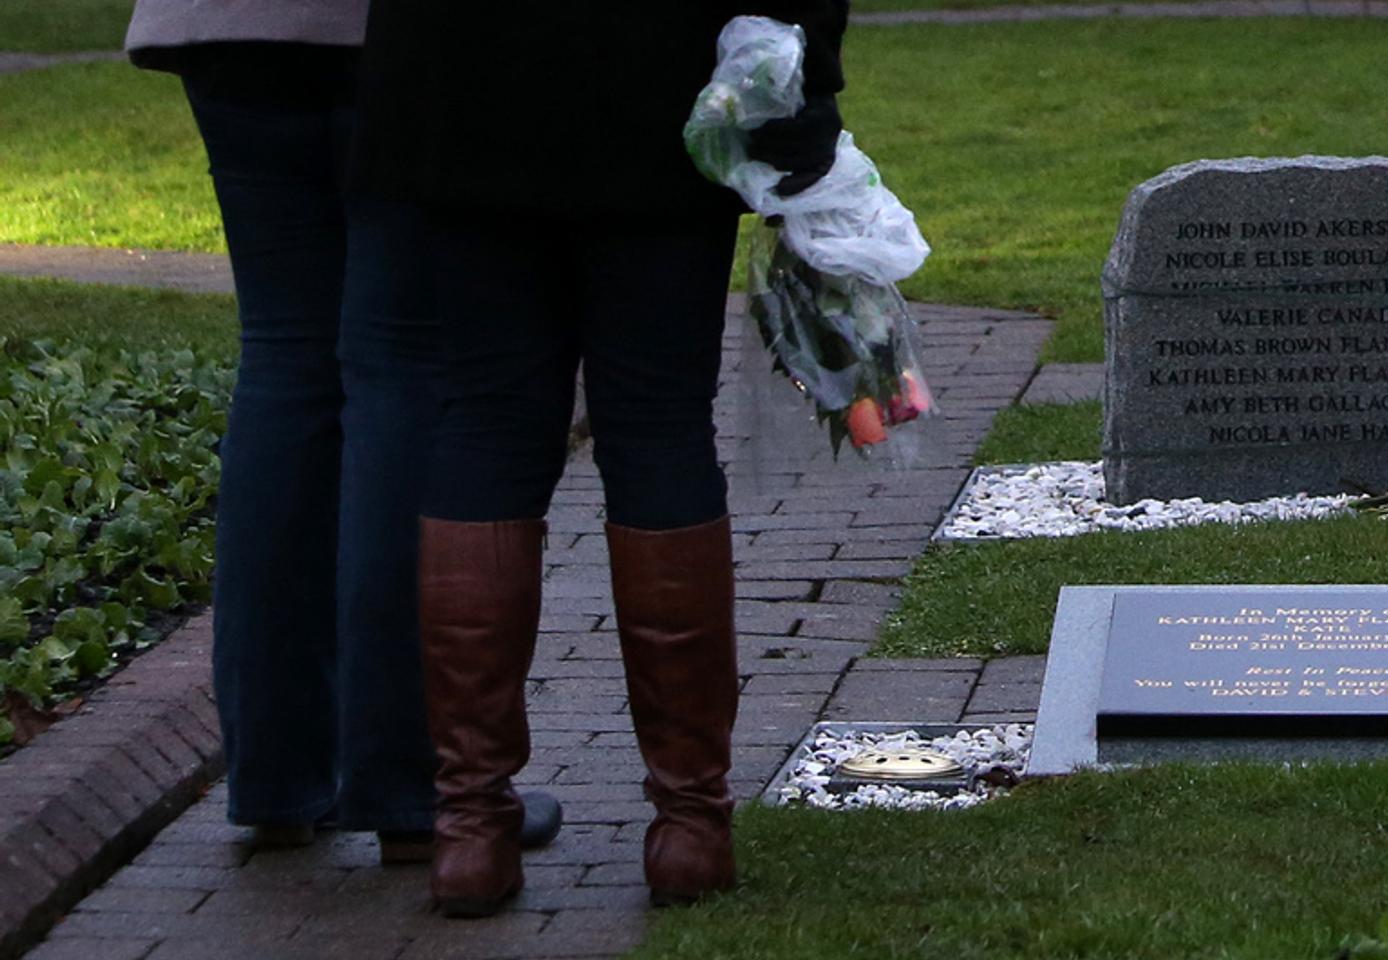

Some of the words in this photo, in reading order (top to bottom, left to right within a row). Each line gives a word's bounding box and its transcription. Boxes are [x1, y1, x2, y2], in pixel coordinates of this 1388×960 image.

[1175, 221, 1231, 240] JOHN
[1240, 220, 1308, 239] DAVID
[1165, 249, 1247, 269] NICOLE
[1256, 249, 1313, 268] ELISE
[1217, 309, 1309, 327] VALERIE
[1155, 338, 1245, 358] THOMAS
[1255, 336, 1331, 355] BROWN
[1148, 368, 1268, 387] KATHLEEN
[1277, 365, 1341, 384] MARY
[1185, 396, 1237, 415] AMY
[1244, 395, 1300, 413] BETH
[1208, 425, 1290, 444] NICOLA
[1301, 424, 1351, 444] JANE
[1240, 608, 1263, 616] In
[1276, 608, 1372, 616] Memory
[1157, 616, 1276, 625] KATHLEEN
[1286, 616, 1349, 624] MARY
[1198, 633, 1249, 641] Born
[1188, 642, 1239, 650] Died
[1249, 642, 1286, 650] 21st
[1245, 666, 1292, 675] Rest
[1302, 666, 1325, 675] In
[1134, 679, 1173, 687] You
[1184, 679, 1224, 687] will
[1303, 679, 1327, 687] be
[1211, 688, 1289, 697] DAVID
[1298, 688, 1312, 696] &
